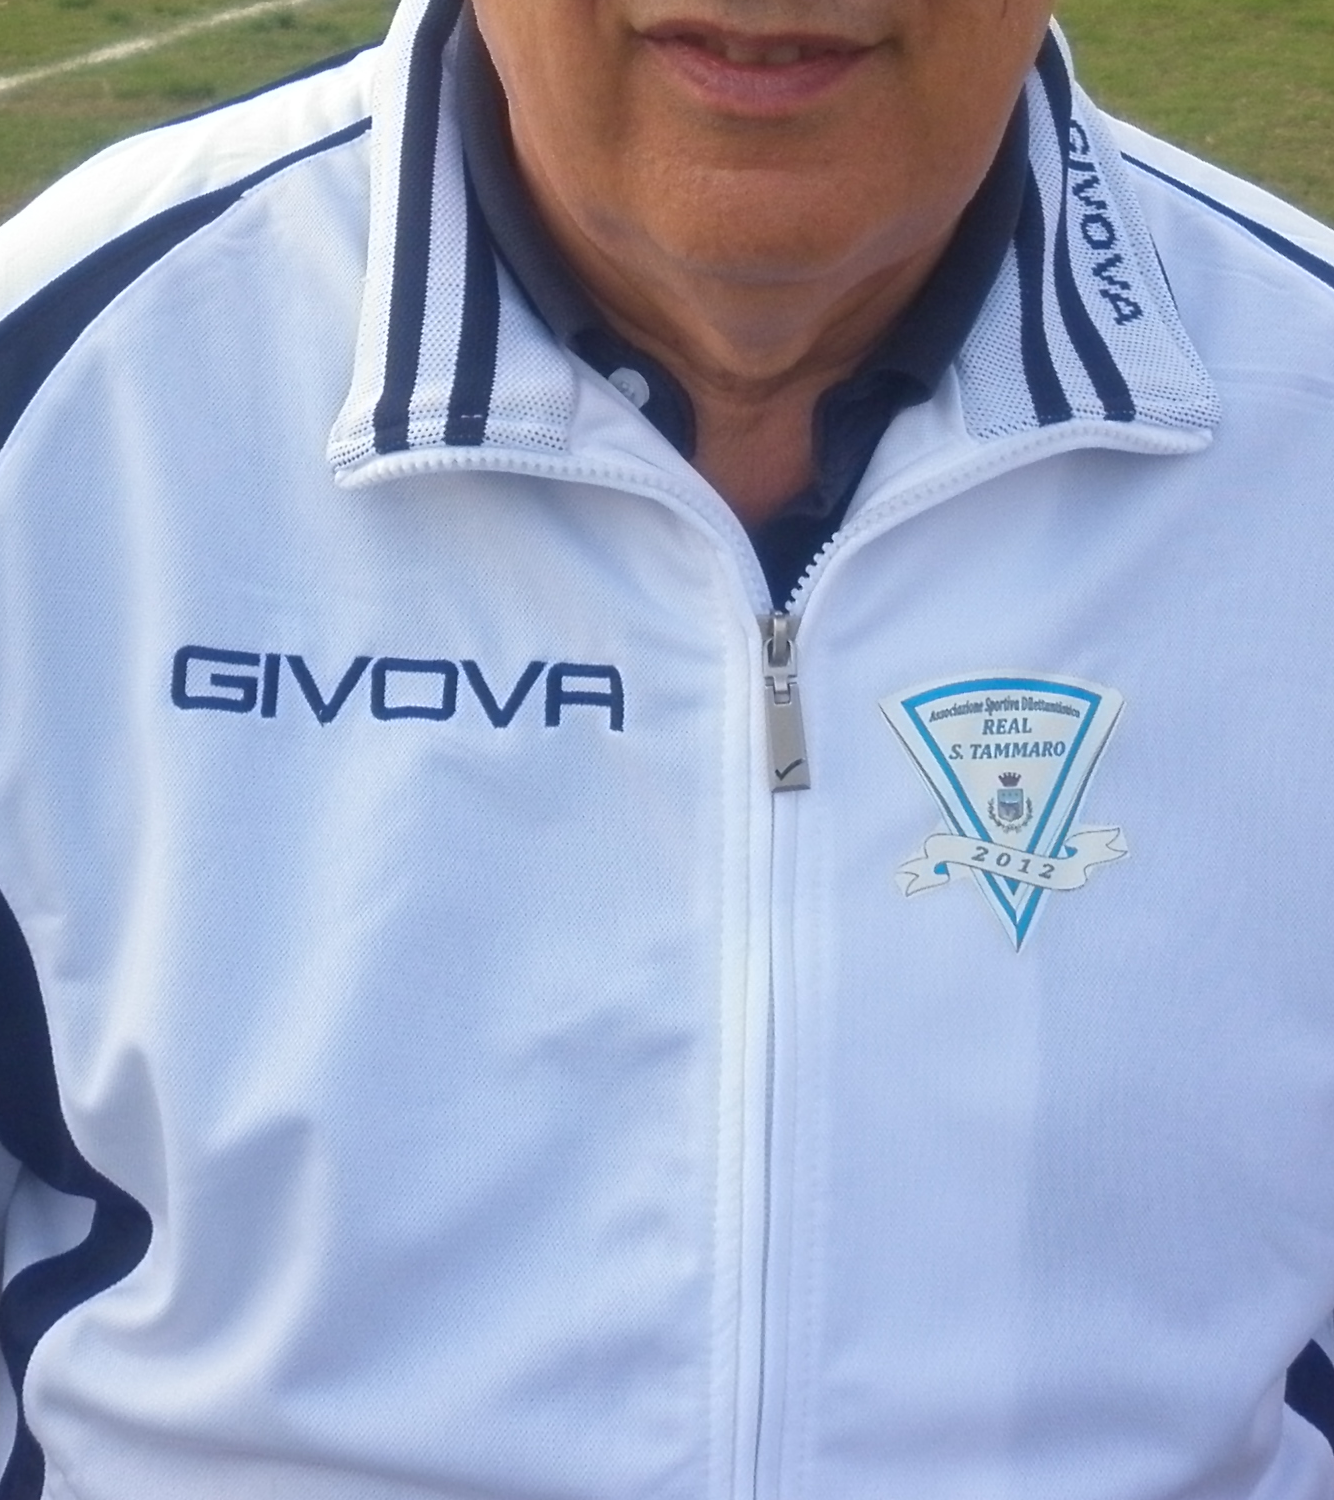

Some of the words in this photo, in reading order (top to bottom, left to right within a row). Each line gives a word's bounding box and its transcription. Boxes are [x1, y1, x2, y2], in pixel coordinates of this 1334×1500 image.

[1068, 118, 1143, 326] GIVOVA
[171, 645, 624, 732] GIVOVA
[929, 702, 983, 722] Associazione
[985, 696, 1019, 716] Sportiva
[982, 718, 1032, 735] REAL
[948, 744, 964, 760] S.
[970, 741, 1066, 759] TAMMARO
[971, 846, 1055, 879] 2012
